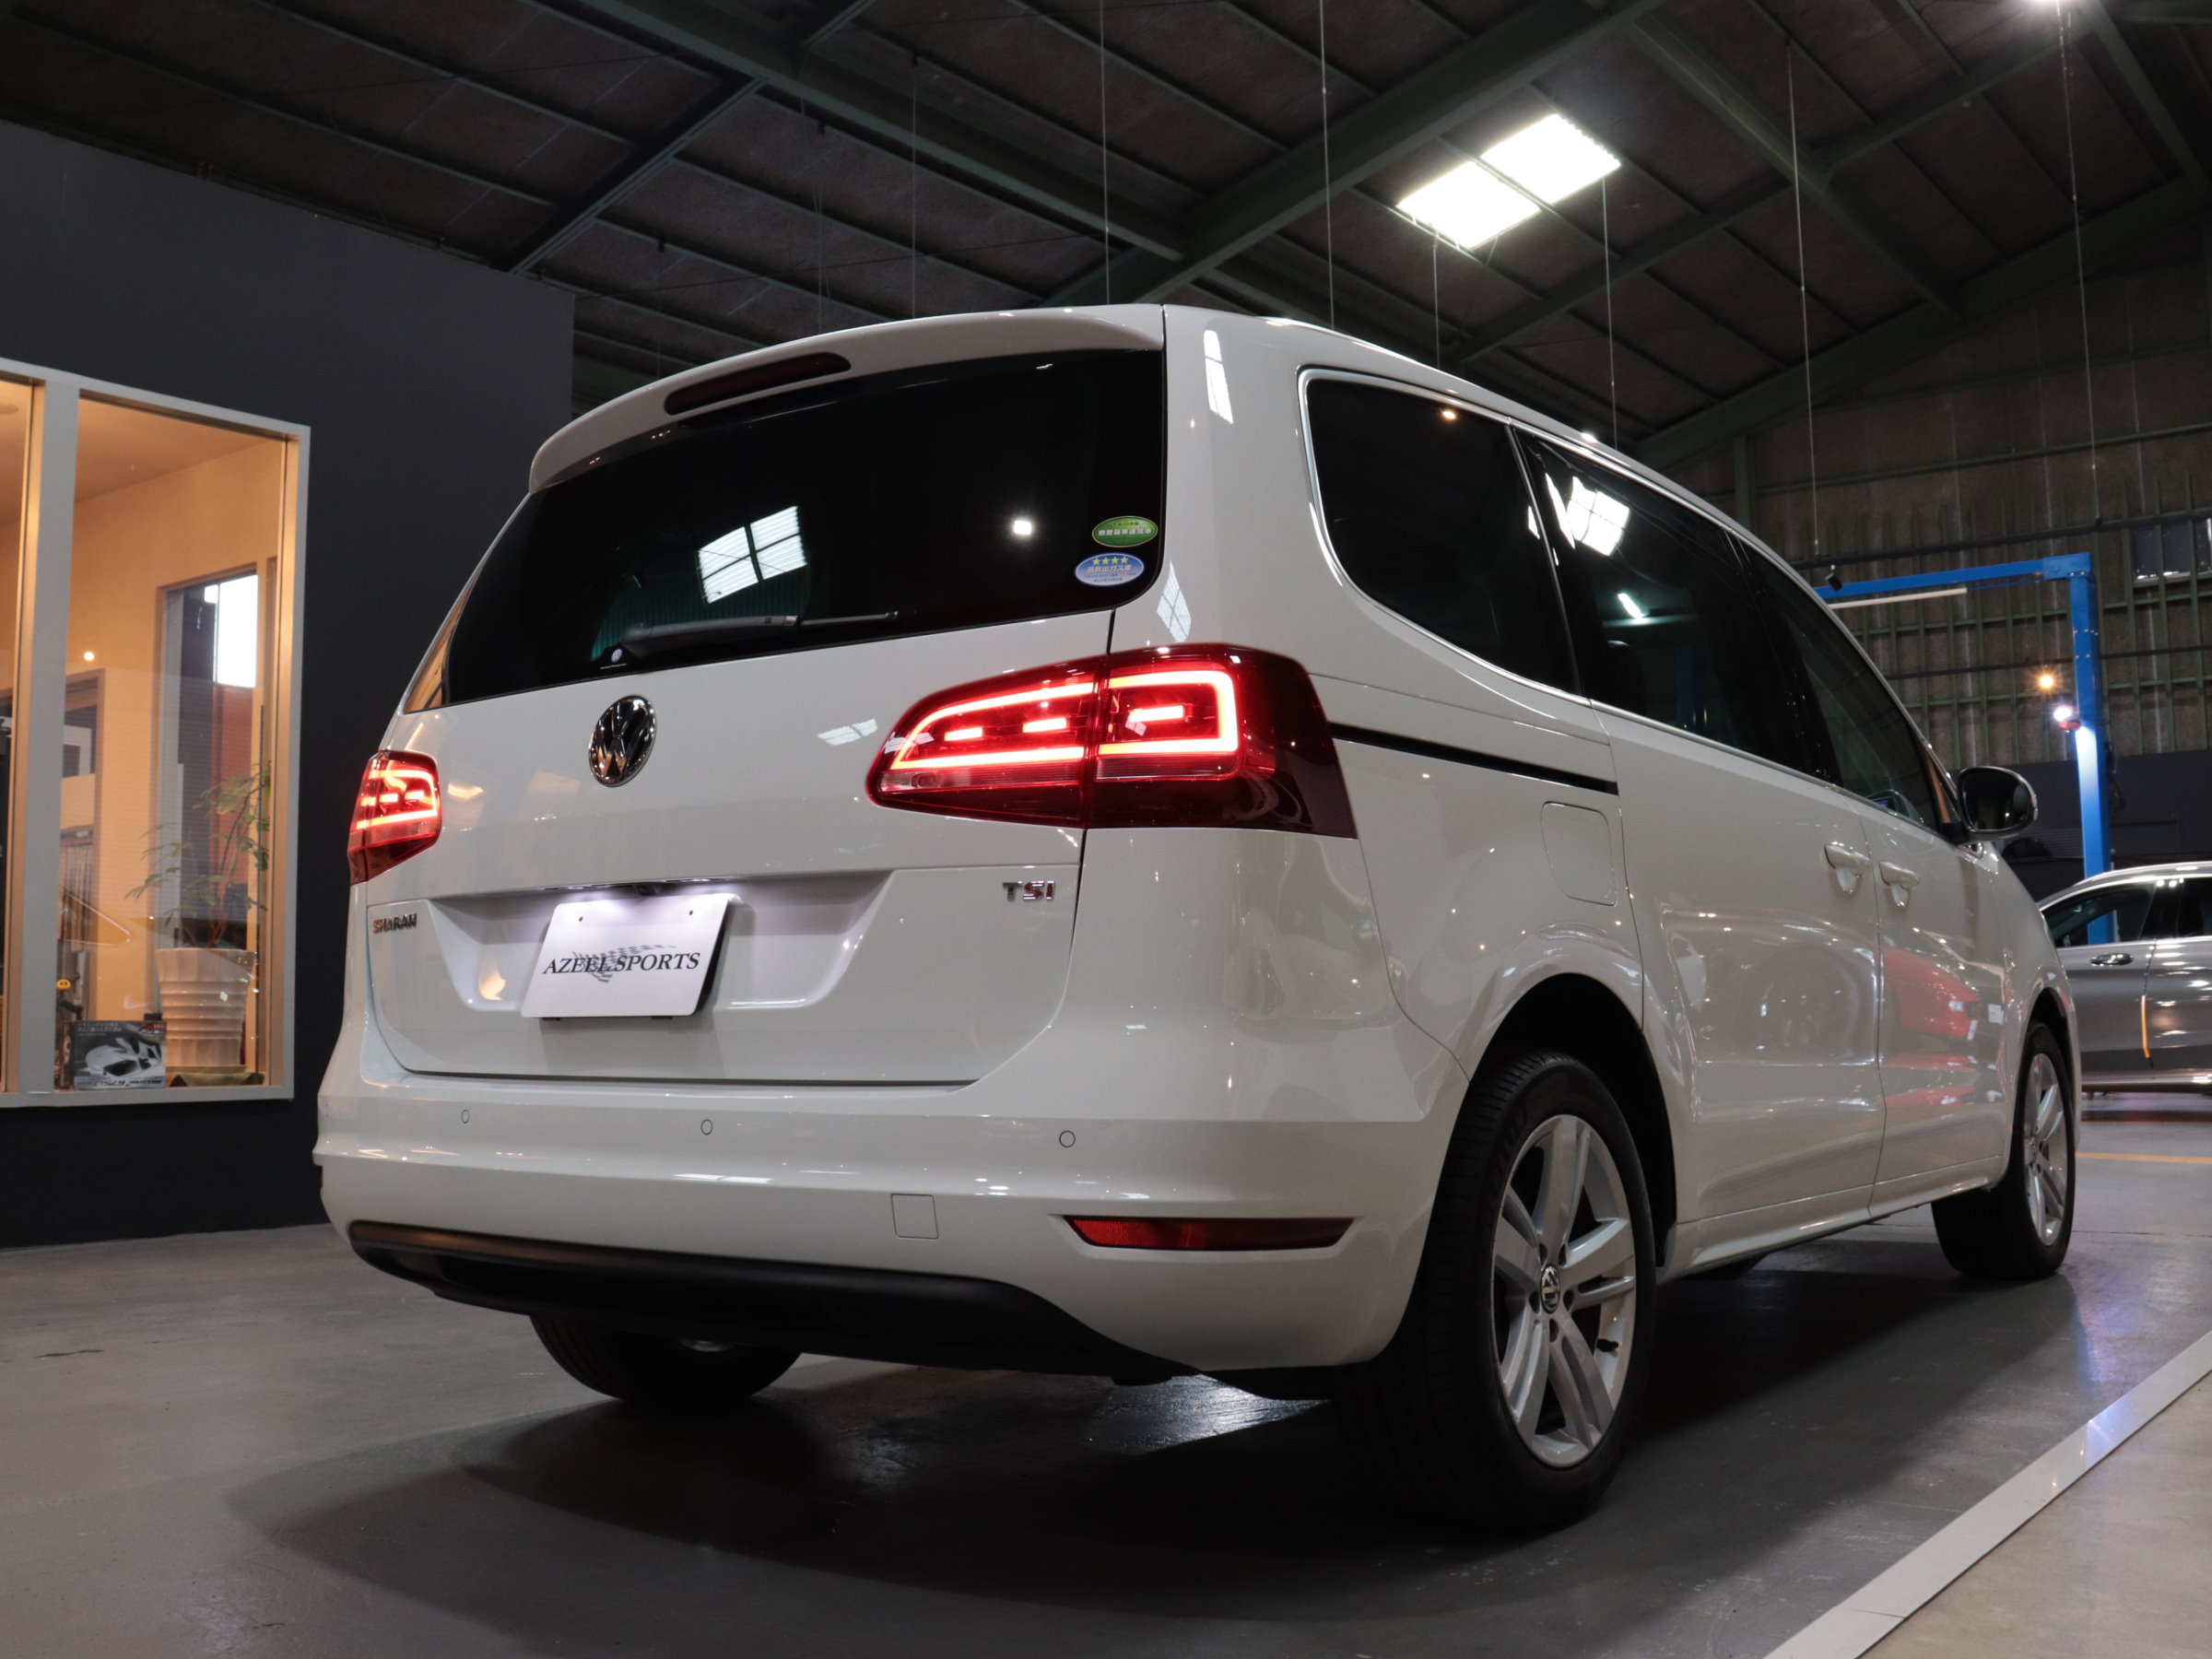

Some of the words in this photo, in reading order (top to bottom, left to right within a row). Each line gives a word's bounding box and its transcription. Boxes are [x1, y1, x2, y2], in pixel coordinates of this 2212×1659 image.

[1002, 880, 1055, 901] TSI
[372, 913, 418, 934] SHARAN
[614, 952, 700, 971] SPORTS
